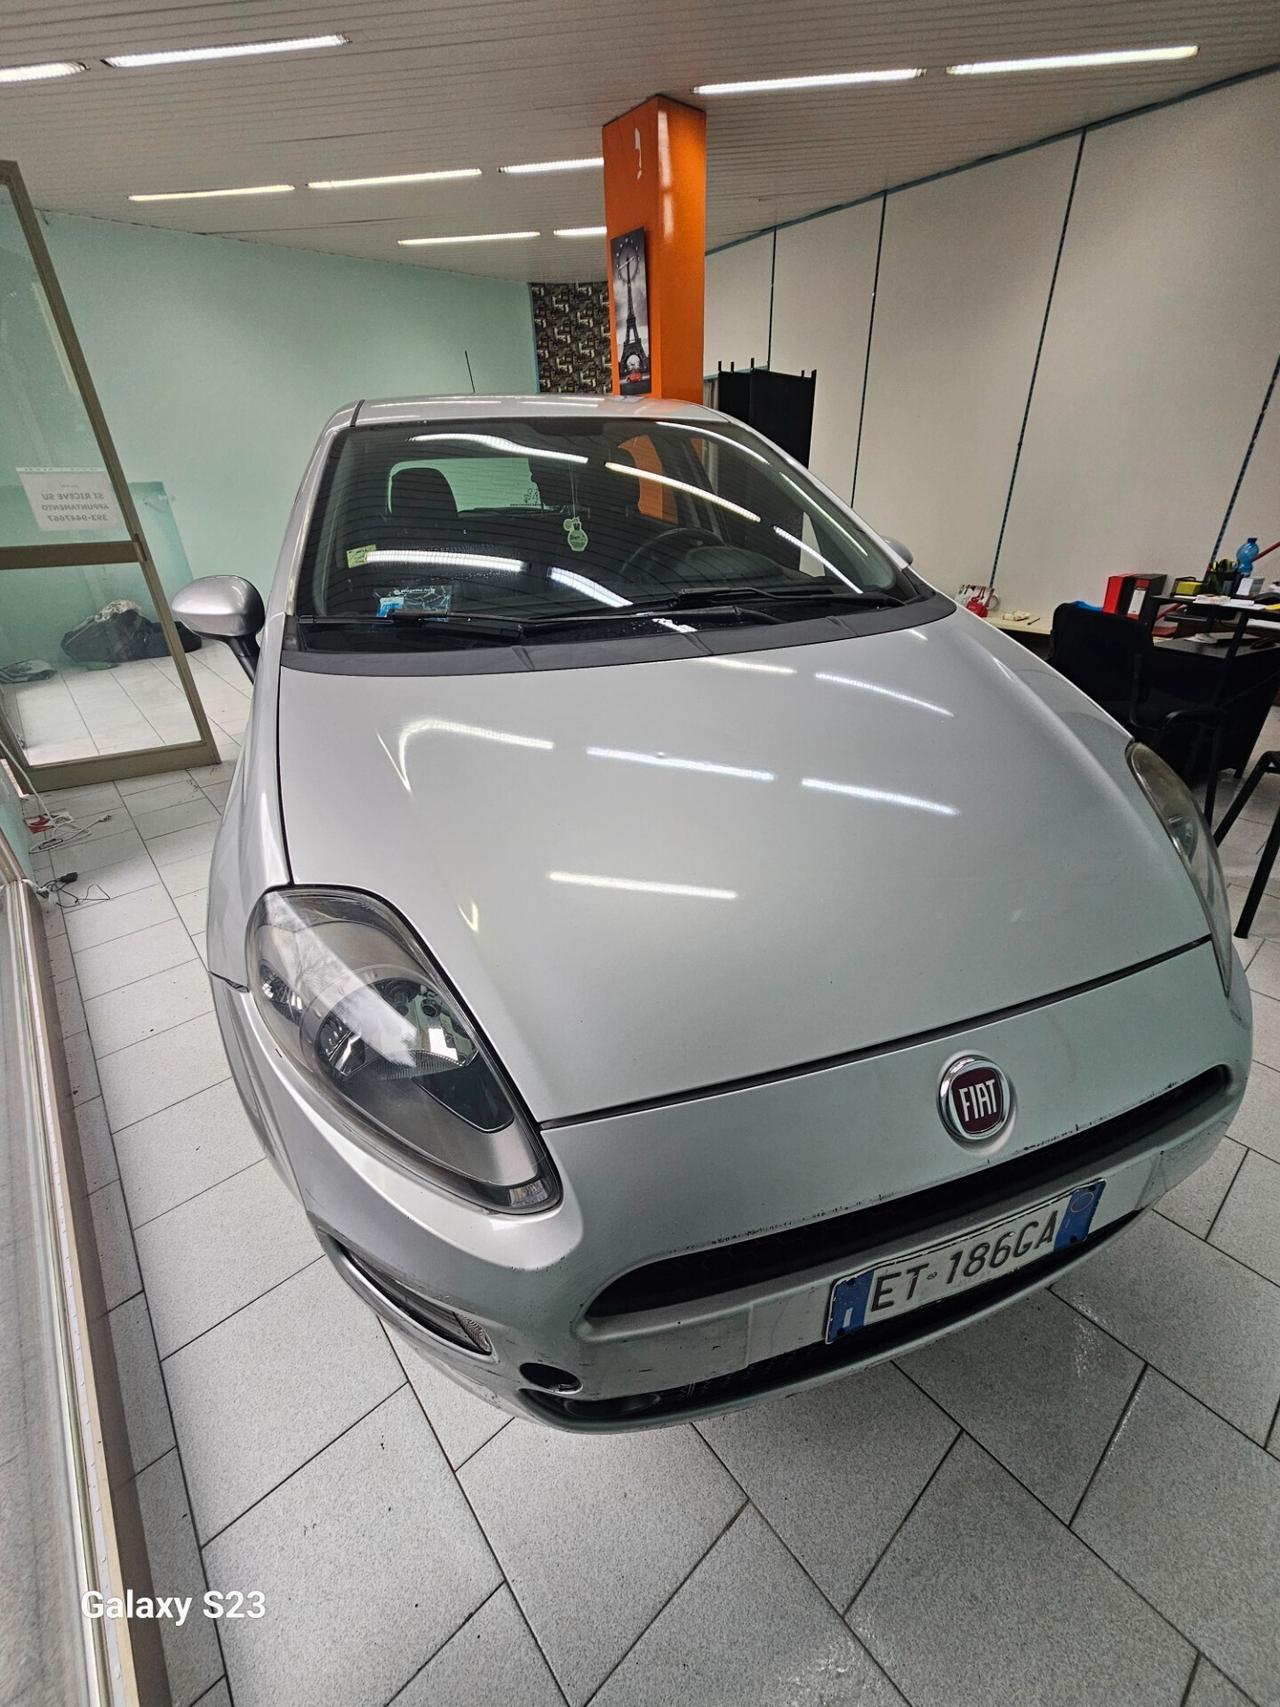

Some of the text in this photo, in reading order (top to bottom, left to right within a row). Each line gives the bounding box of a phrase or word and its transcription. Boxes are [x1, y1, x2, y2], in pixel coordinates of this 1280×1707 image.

[958, 1078, 997, 1122] FIAT
[870, 1209, 1059, 1313] ET 186GA
